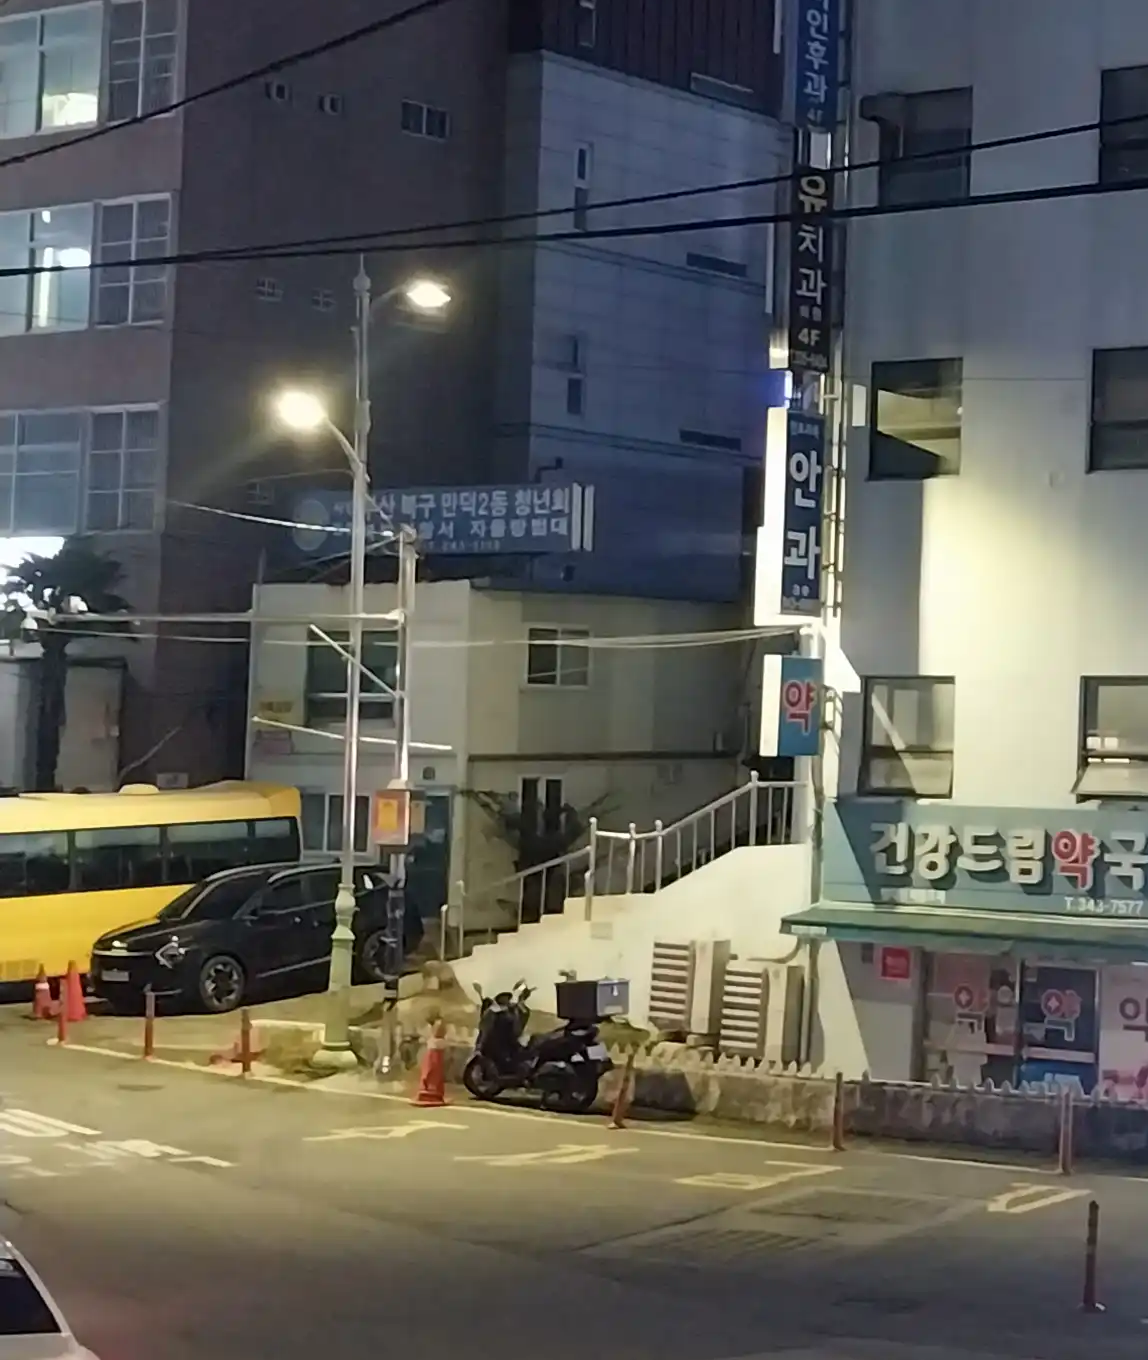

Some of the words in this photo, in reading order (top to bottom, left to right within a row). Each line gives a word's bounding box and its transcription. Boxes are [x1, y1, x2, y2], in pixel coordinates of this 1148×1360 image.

[795, 174, 827, 306] 유치과
[441, 489, 509, 520] 만덕2동
[785, 448, 822, 580] 안과
[784, 683, 816, 736] 약
